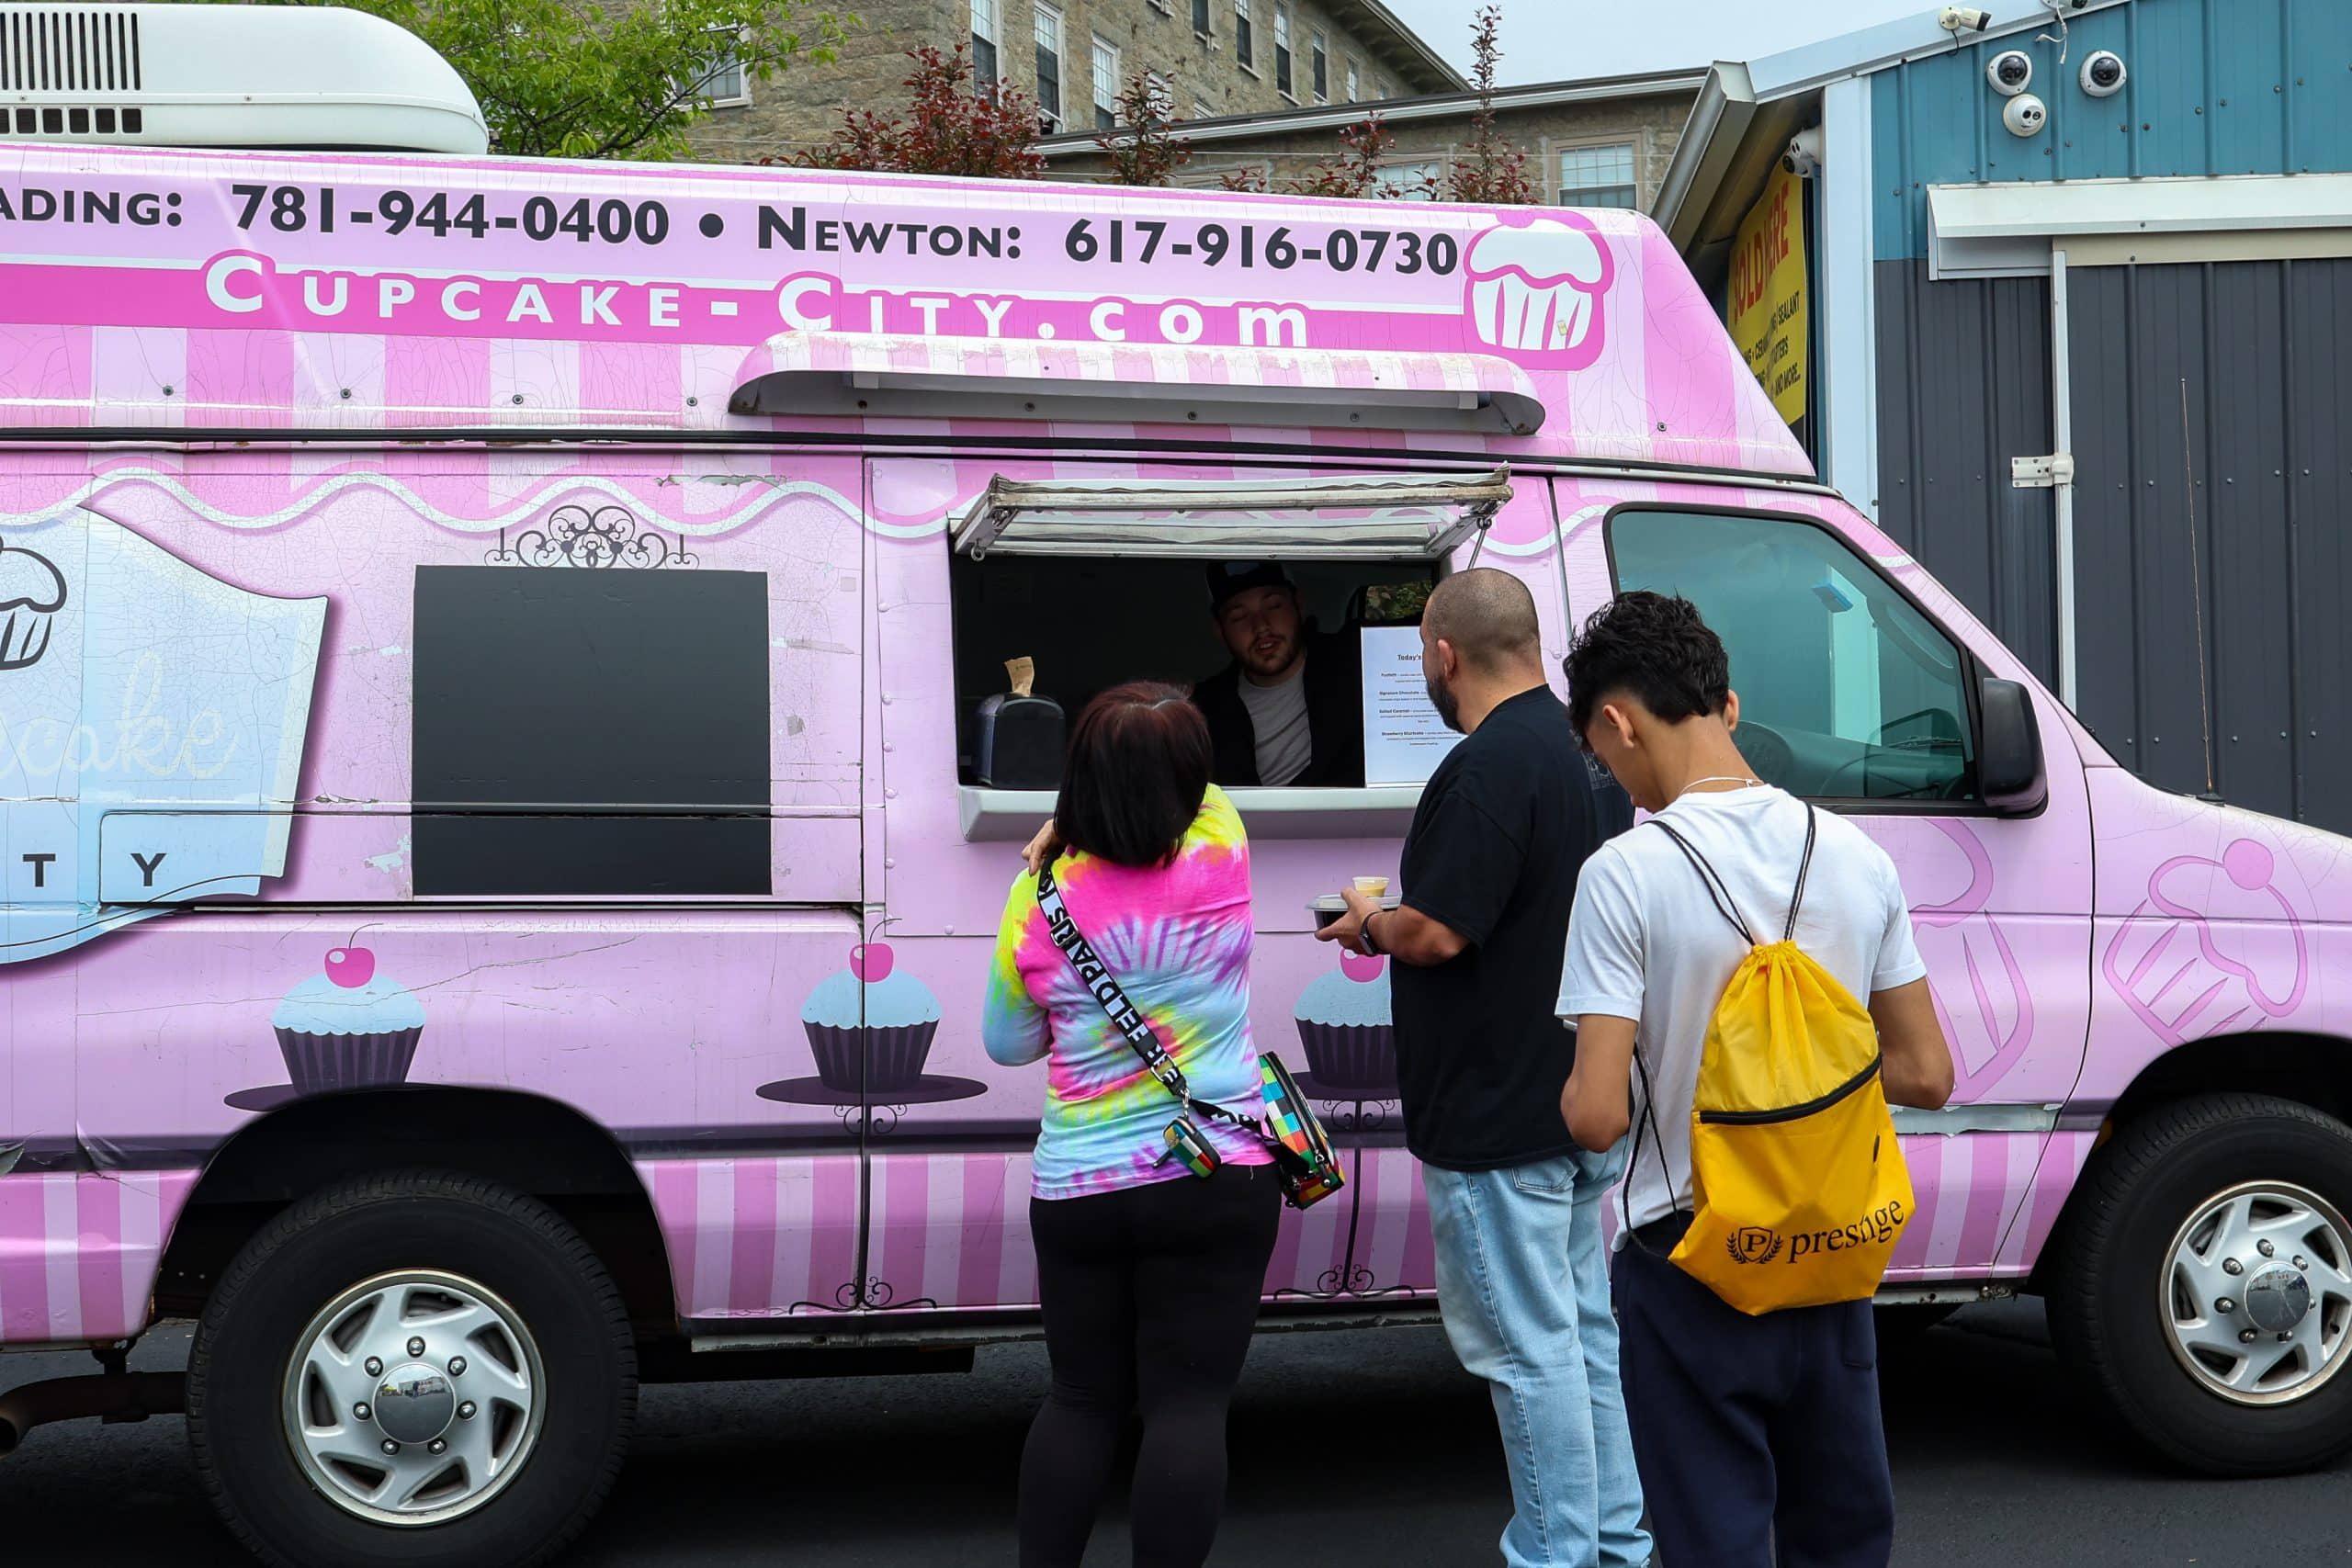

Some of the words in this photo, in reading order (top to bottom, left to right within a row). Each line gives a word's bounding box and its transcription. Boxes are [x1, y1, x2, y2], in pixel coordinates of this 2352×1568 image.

[232, 184, 669, 246] 781-944-0400
[758, 205, 1021, 259] NEWTON:
[1065, 219, 1458, 276] 617-916-0730
[0, 651, 239, 779] cake
[1786, 1199, 1905, 1265] prestige
